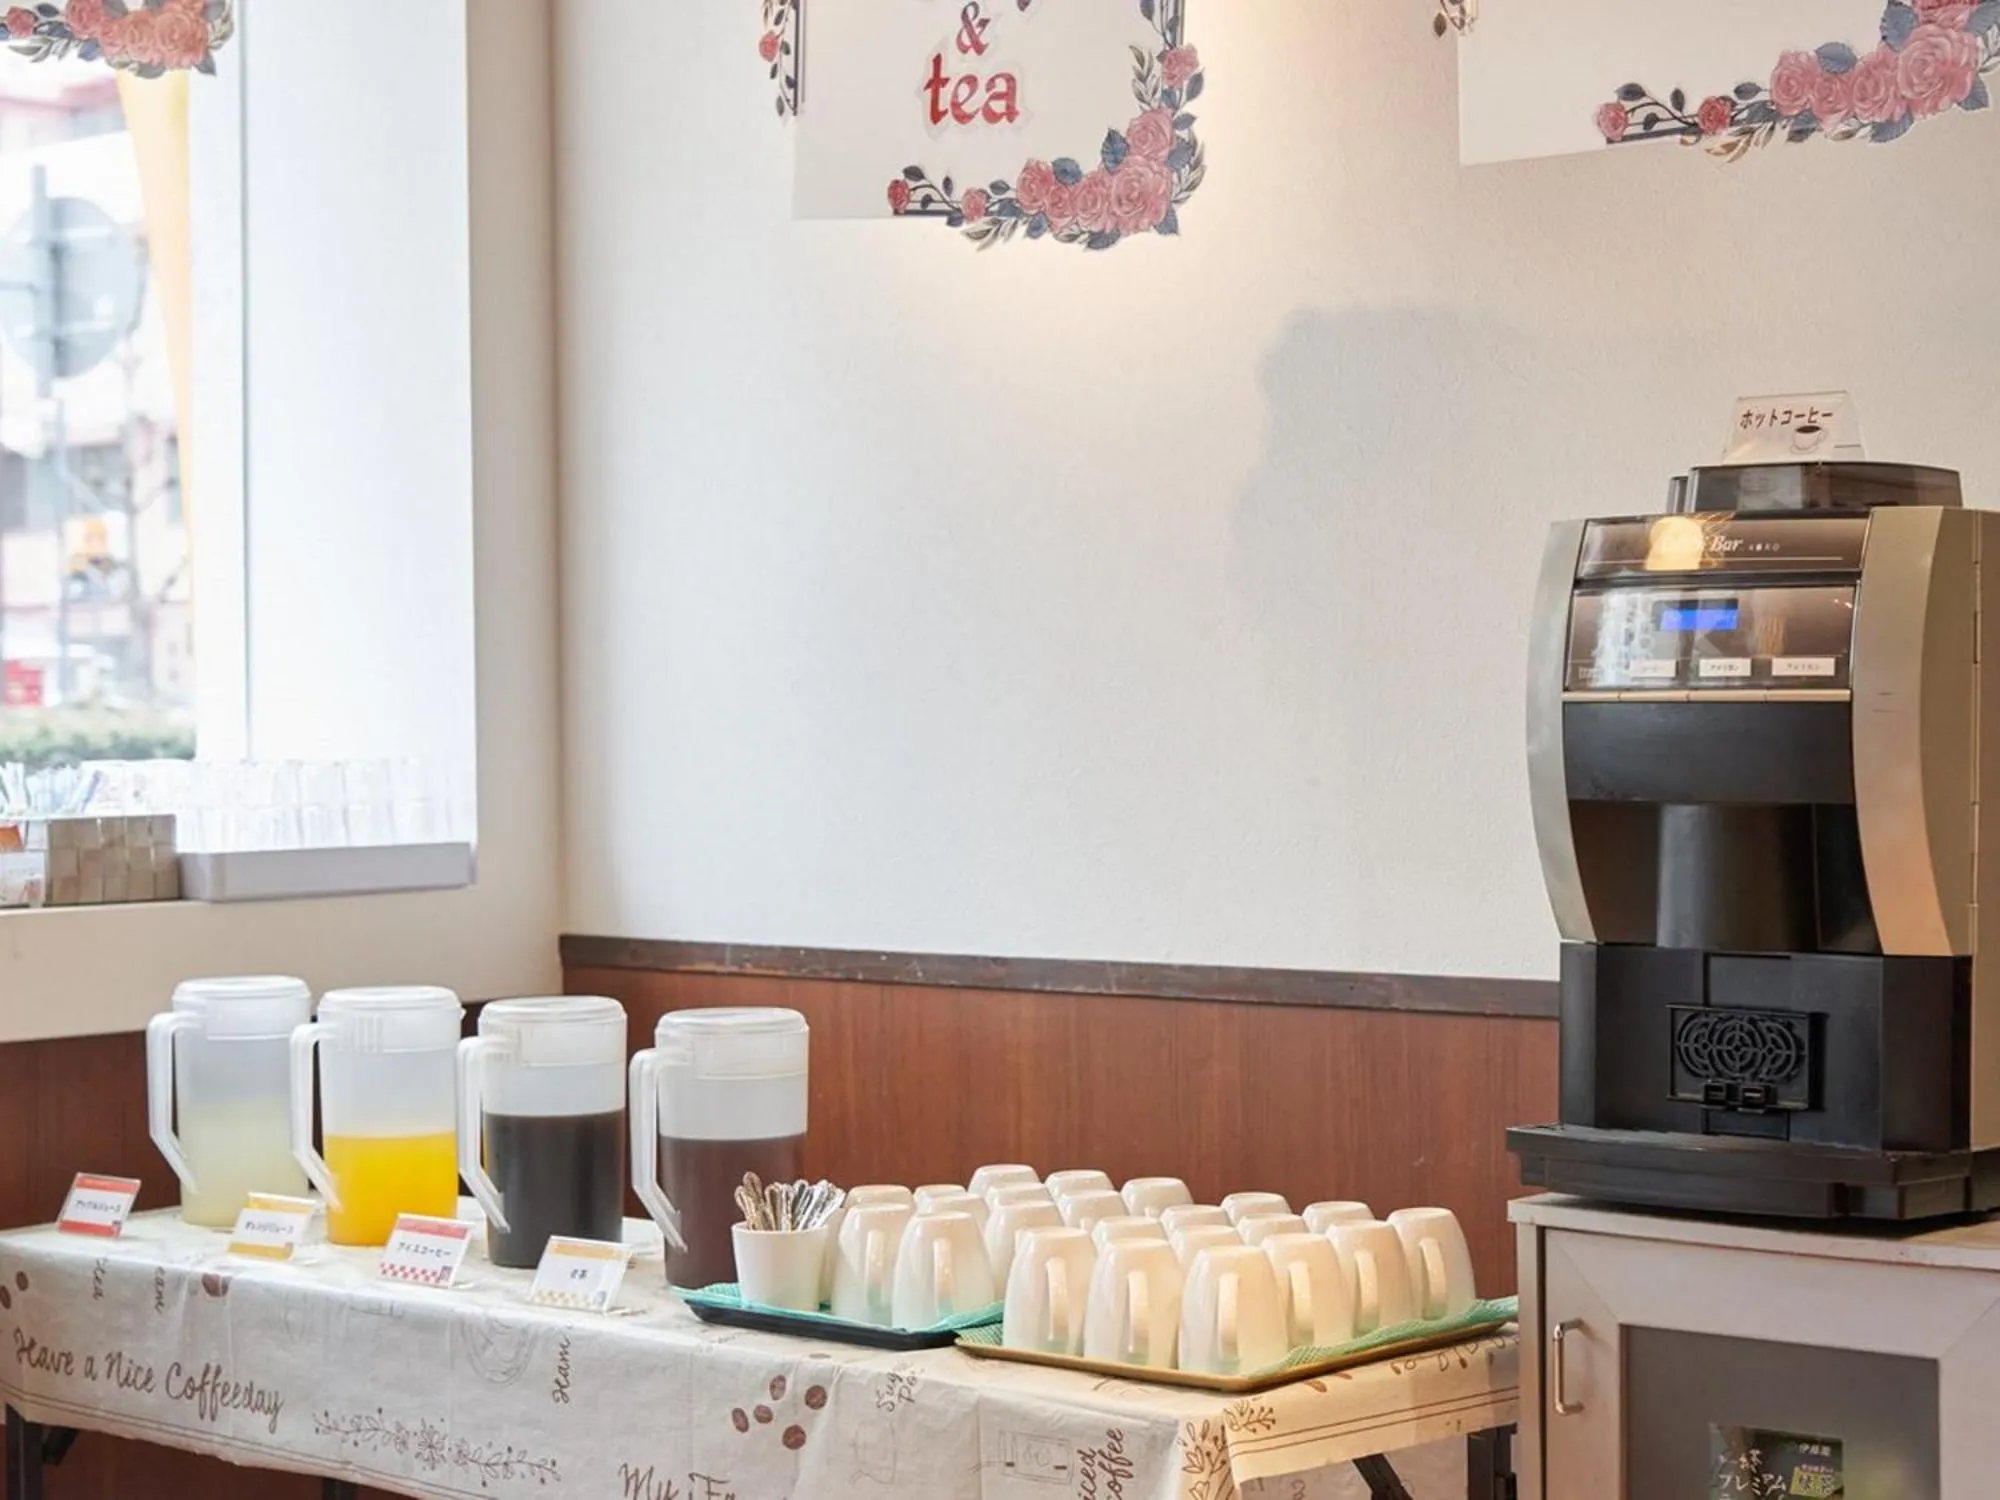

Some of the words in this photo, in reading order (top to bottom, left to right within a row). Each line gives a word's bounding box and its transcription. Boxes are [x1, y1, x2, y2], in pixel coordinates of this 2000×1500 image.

[956, 0, 990, 56] &
[923, 53, 1020, 126] tea
[1740, 405, 1833, 430] ホットコーヒー
[1708, 536, 1743, 553] Bar
[14, 1327, 74, 1377] Have
[83, 1355, 97, 1381] a
[104, 1350, 156, 1394] Nice
[165, 1361, 285, 1434] Coffeeday
[1718, 1472, 1787, 1497] プレミアム
